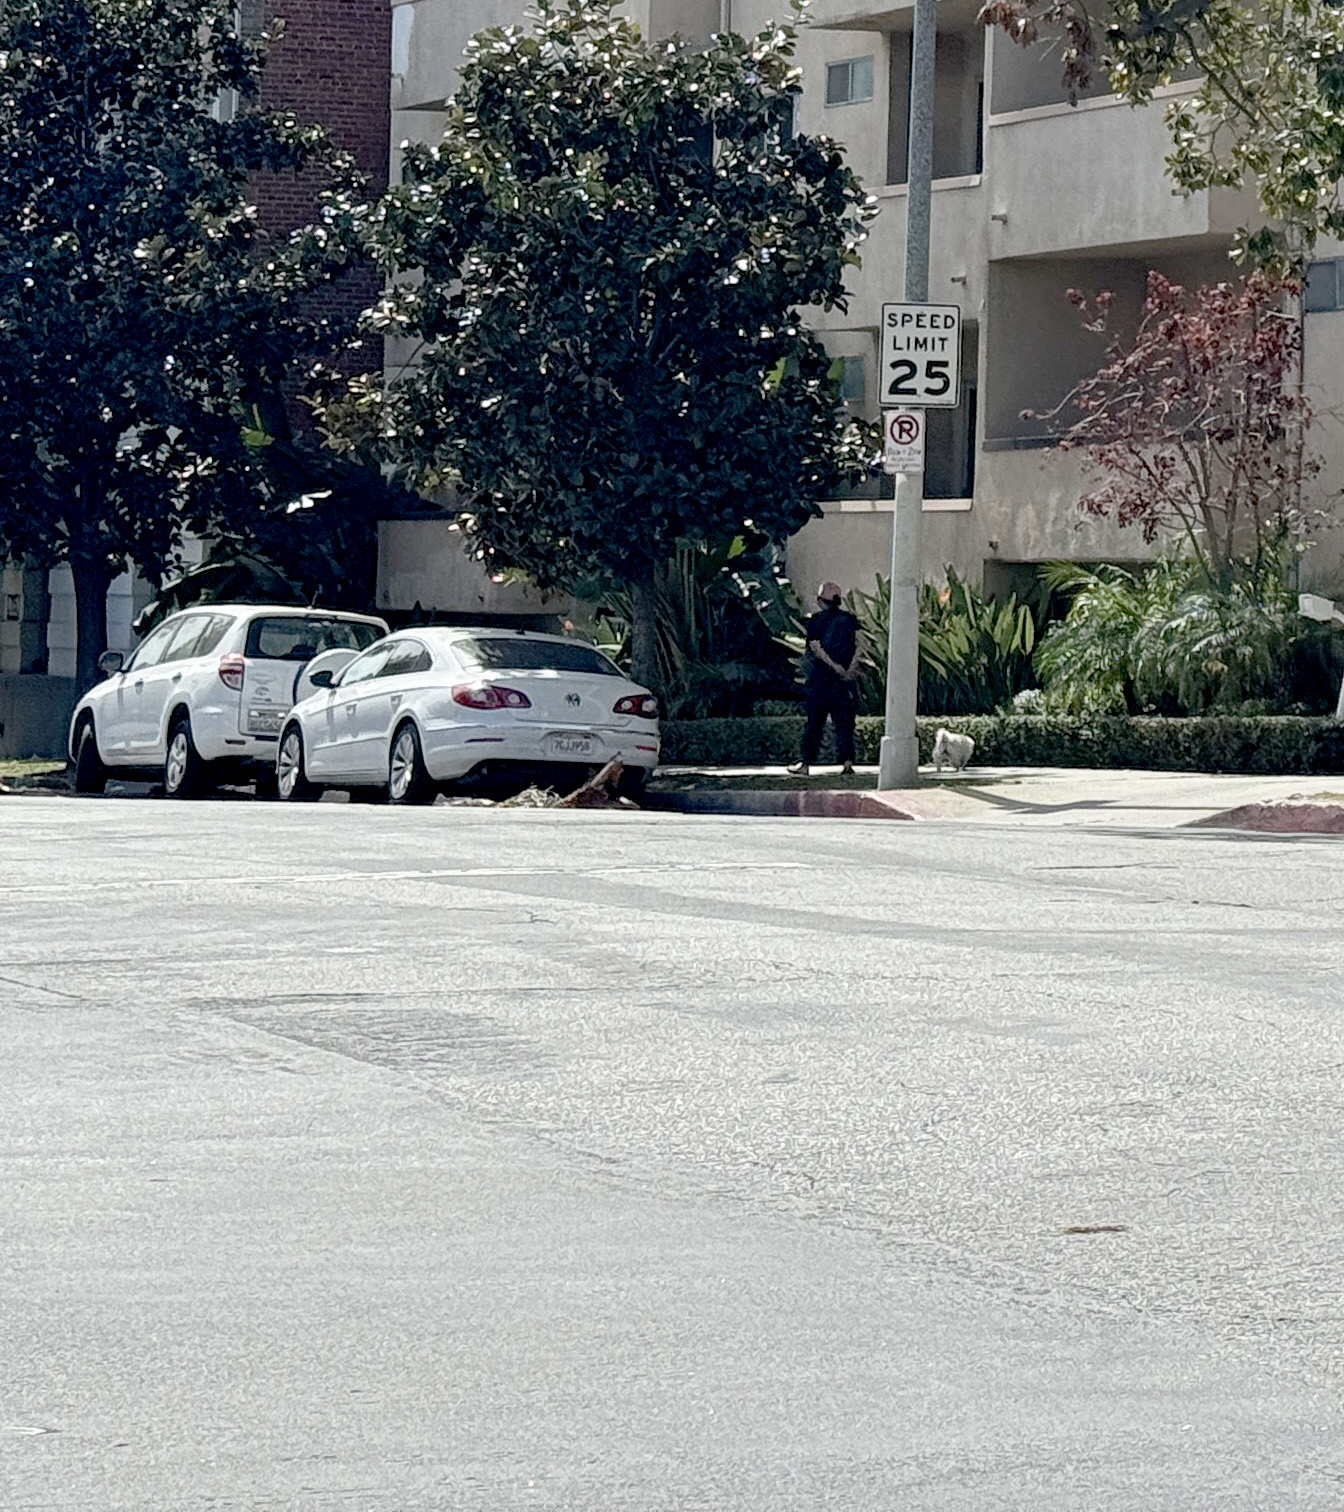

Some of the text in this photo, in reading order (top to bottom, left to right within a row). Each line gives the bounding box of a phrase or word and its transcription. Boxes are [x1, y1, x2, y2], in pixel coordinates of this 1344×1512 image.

[887, 312, 956, 329] SPEED
[893, 335, 948, 352] LIMIT
[888, 359, 950, 396] 25
